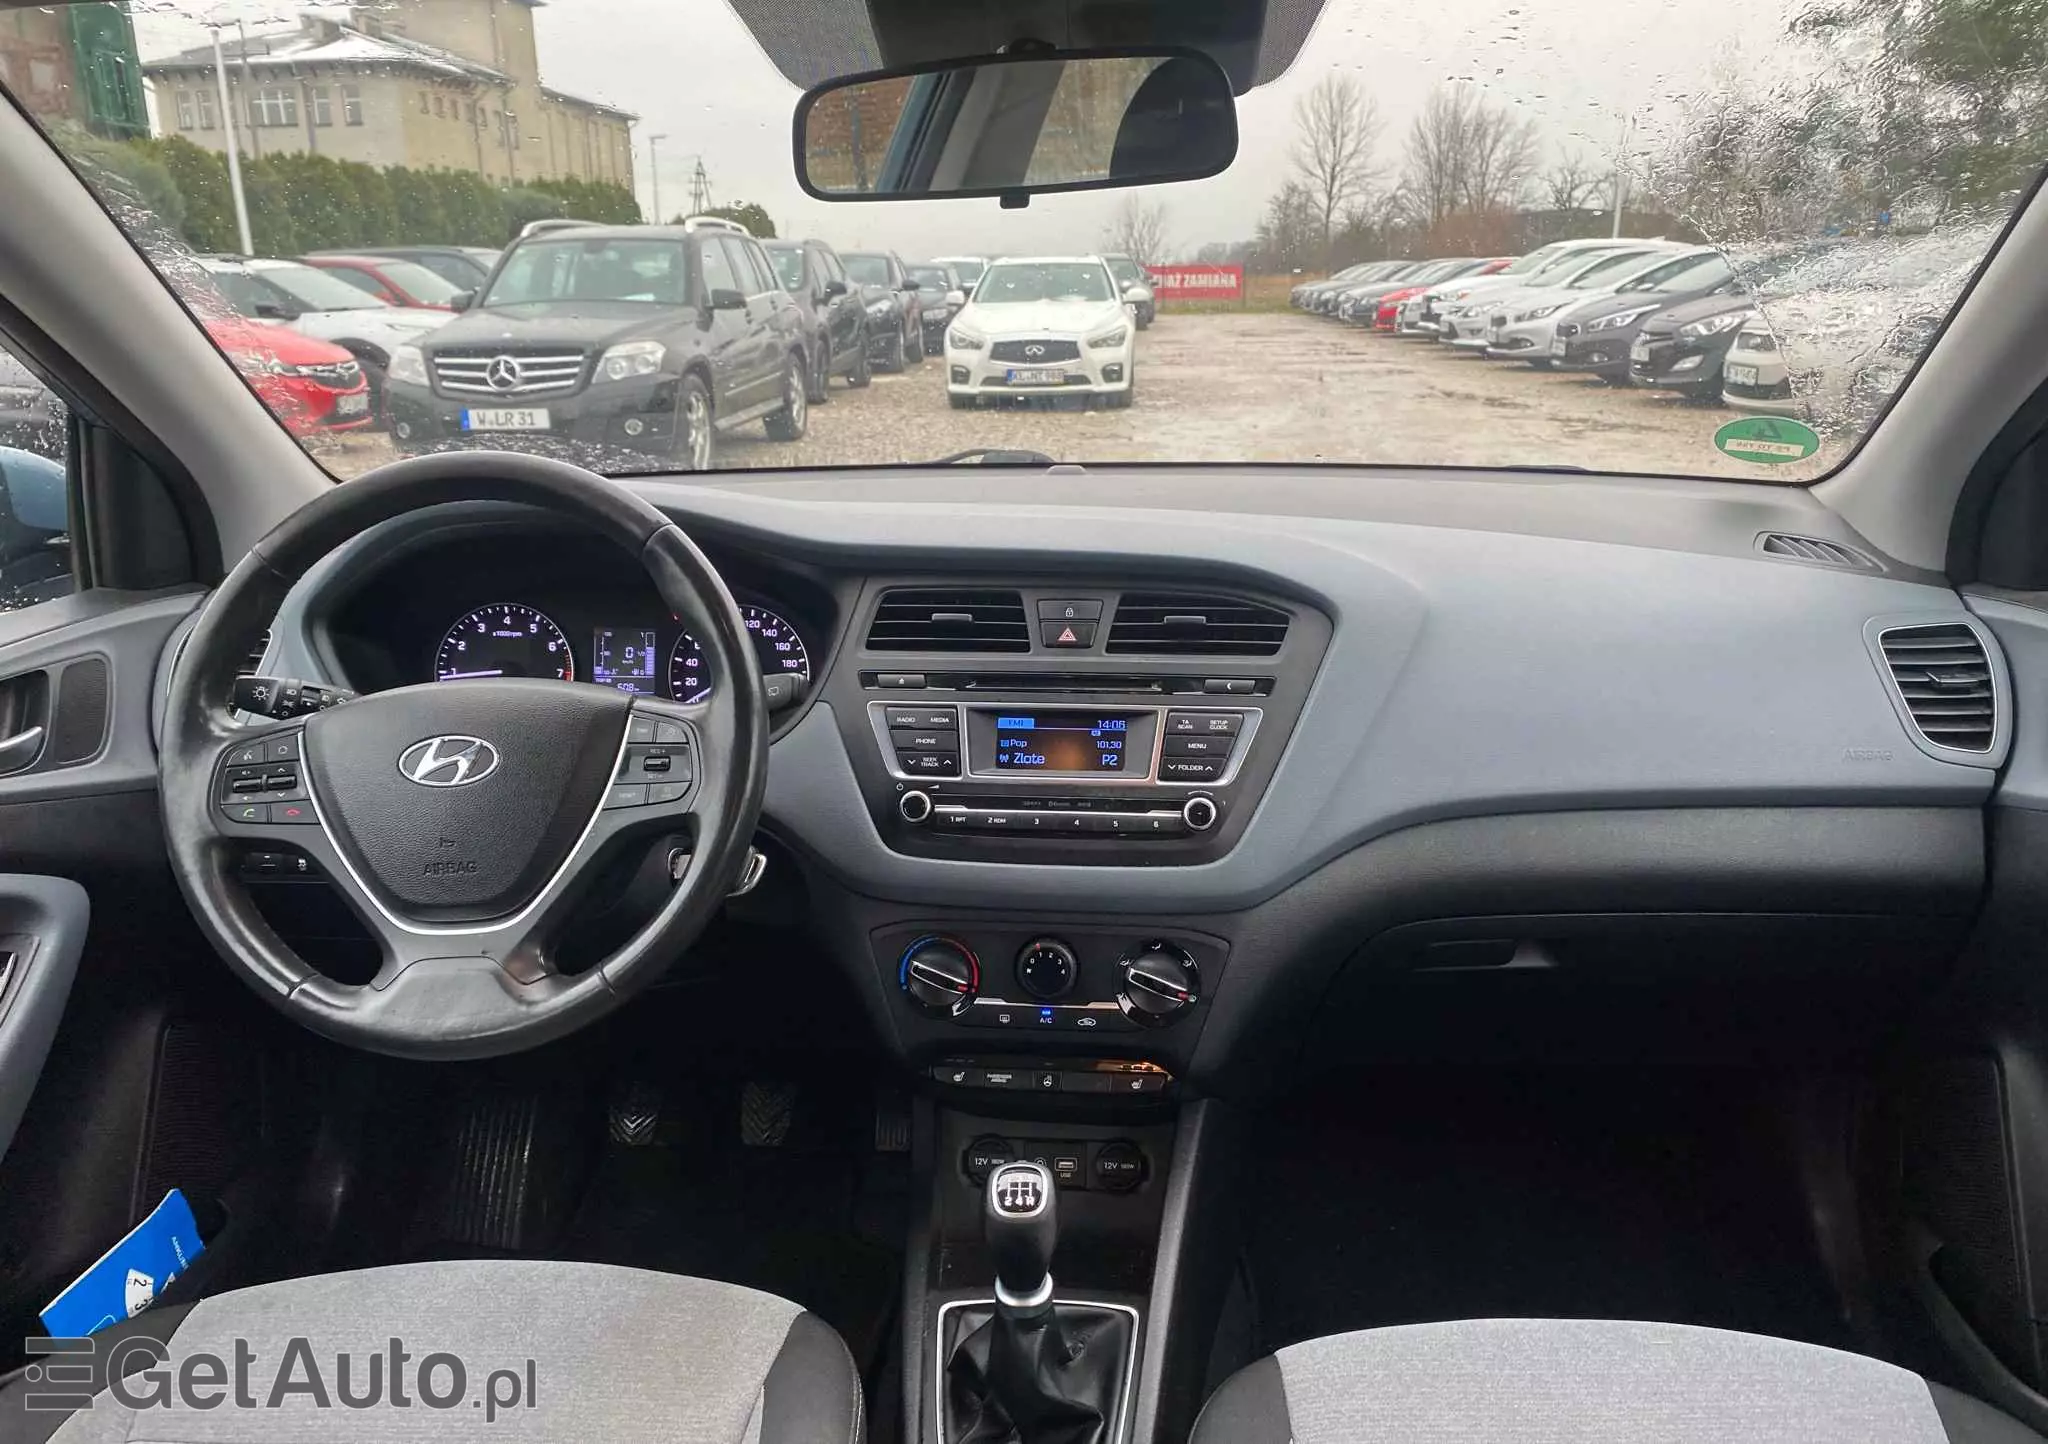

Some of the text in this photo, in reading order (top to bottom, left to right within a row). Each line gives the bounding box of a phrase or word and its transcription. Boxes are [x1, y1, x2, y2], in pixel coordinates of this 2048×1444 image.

[518, 411, 536, 426] 31
[503, 616, 511, 625] 4
[745, 620, 760, 628] 120
[477, 623, 486, 633] 3
[529, 624, 537, 633] 5
[762, 629, 778, 637] 140
[458, 641, 466, 651] 2
[548, 642, 557, 651] 6
[775, 643, 791, 651] 160
[625, 646, 634, 658] 0
[685, 658, 698, 667] 40
[782, 659, 798, 668] 180
[556, 668, 564, 678] 7
[685, 677, 697, 686] 20
[1010, 738, 1028, 748] Pop
[1102, 754, 1118, 766] P2
[974, 1157, 988, 1165] 12V
[1103, 1162, 1118, 1170] 12V
[1004, 1196, 1012, 1206] 2
[133, 1278, 147, 1287] 2
